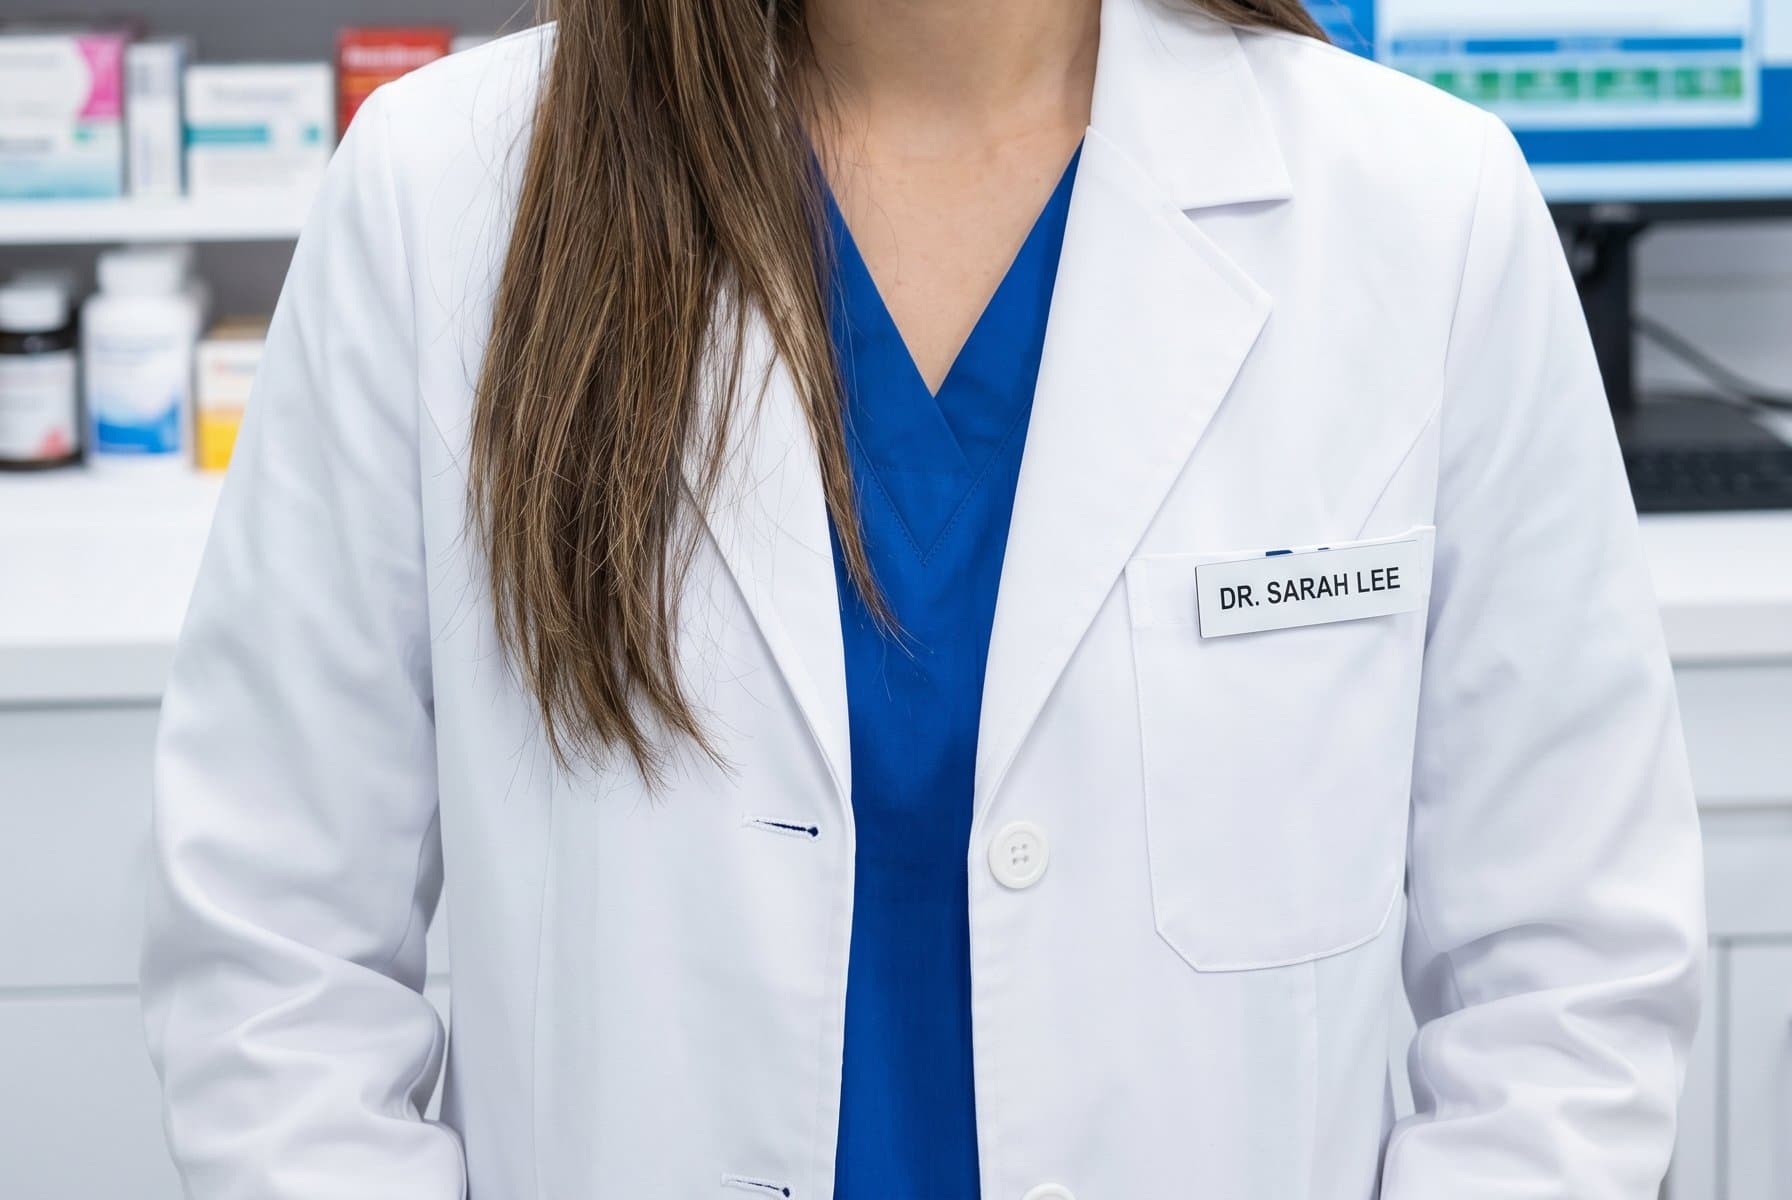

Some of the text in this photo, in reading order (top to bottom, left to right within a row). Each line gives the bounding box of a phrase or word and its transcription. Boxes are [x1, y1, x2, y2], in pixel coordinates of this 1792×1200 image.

[1219, 566, 1401, 610] DR. SARAH LEE
